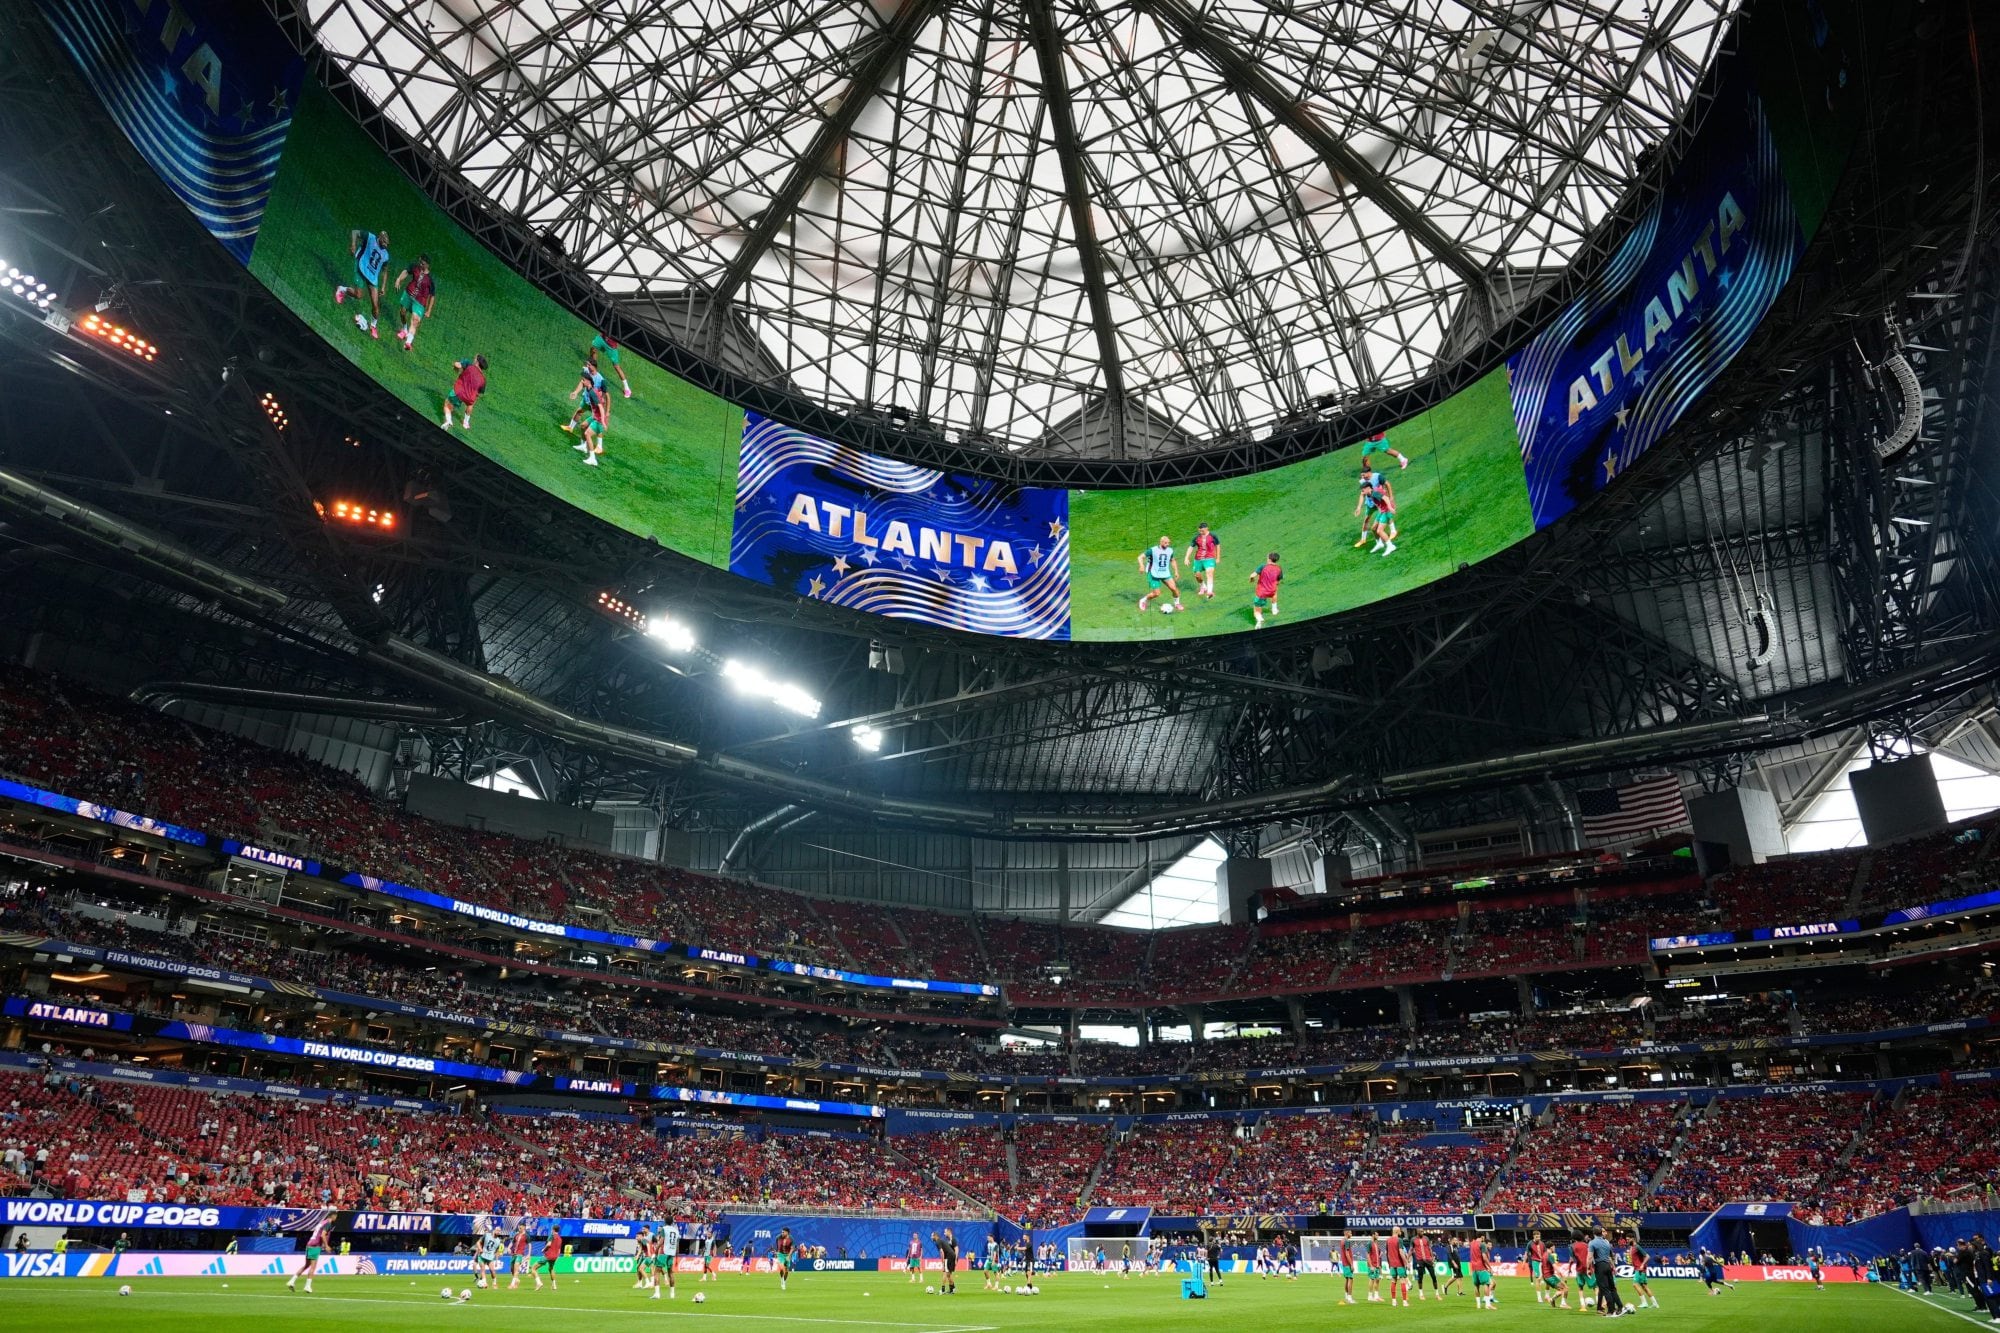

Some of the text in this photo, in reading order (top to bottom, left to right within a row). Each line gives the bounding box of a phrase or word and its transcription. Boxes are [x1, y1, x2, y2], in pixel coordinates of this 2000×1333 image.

[1568, 191, 1746, 427] ATLANTA
[786, 493, 1019, 575] ATLANTA
[240, 844, 304, 872] ATLANTA
[453, 900, 566, 936] FIFA WORLD CUP 2026
[1773, 922, 1838, 938] ATLANTA
[700, 949, 746, 965] ATLANTA
[107, 952, 221, 979] FIFA WORLD CUP 2026
[29, 1003, 109, 1026] ATLANTA
[426, 1009, 475, 1025] ATLANTA
[303, 1042, 435, 1071] FIFA WORLD CUP 2026
[1622, 1044, 1681, 1055] ATLANTA
[1430, 1059, 1456, 1067] WORLD
[1471, 1056, 1496, 1064] 2026
[857, 1066, 868, 1074] FIFA
[868, 1067, 888, 1075] WORLD
[888, 1069, 900, 1077] CUP
[1261, 1069, 1307, 1077] ATLANTA
[1764, 1084, 1827, 1095] ATLANTA
[1435, 1100, 1487, 1109] ATLANTA
[905, 1110, 918, 1118] FIFA
[918, 1111, 940, 1119] WORLD
[7, 1201, 220, 1226] WORLD CUP 2026
[353, 1214, 432, 1231] ATLANTA
[1346, 1216, 1465, 1227] FIFA WORLD CUP 2026
[582, 1222, 631, 1237] #FIFAWorldCup
[754, 1230, 771, 1239] FIFA
[4, 1253, 66, 1276] VISA
[386, 1259, 410, 1271] FIFA
[410, 1259, 445, 1271] WORLD
[445, 1259, 467, 1271] CUP
[574, 1256, 634, 1273] aramco
[826, 1259, 855, 1270] HYUNDAI
[1069, 1260, 1098, 1271] QATA
[1762, 1266, 1826, 1281] Lenovo
